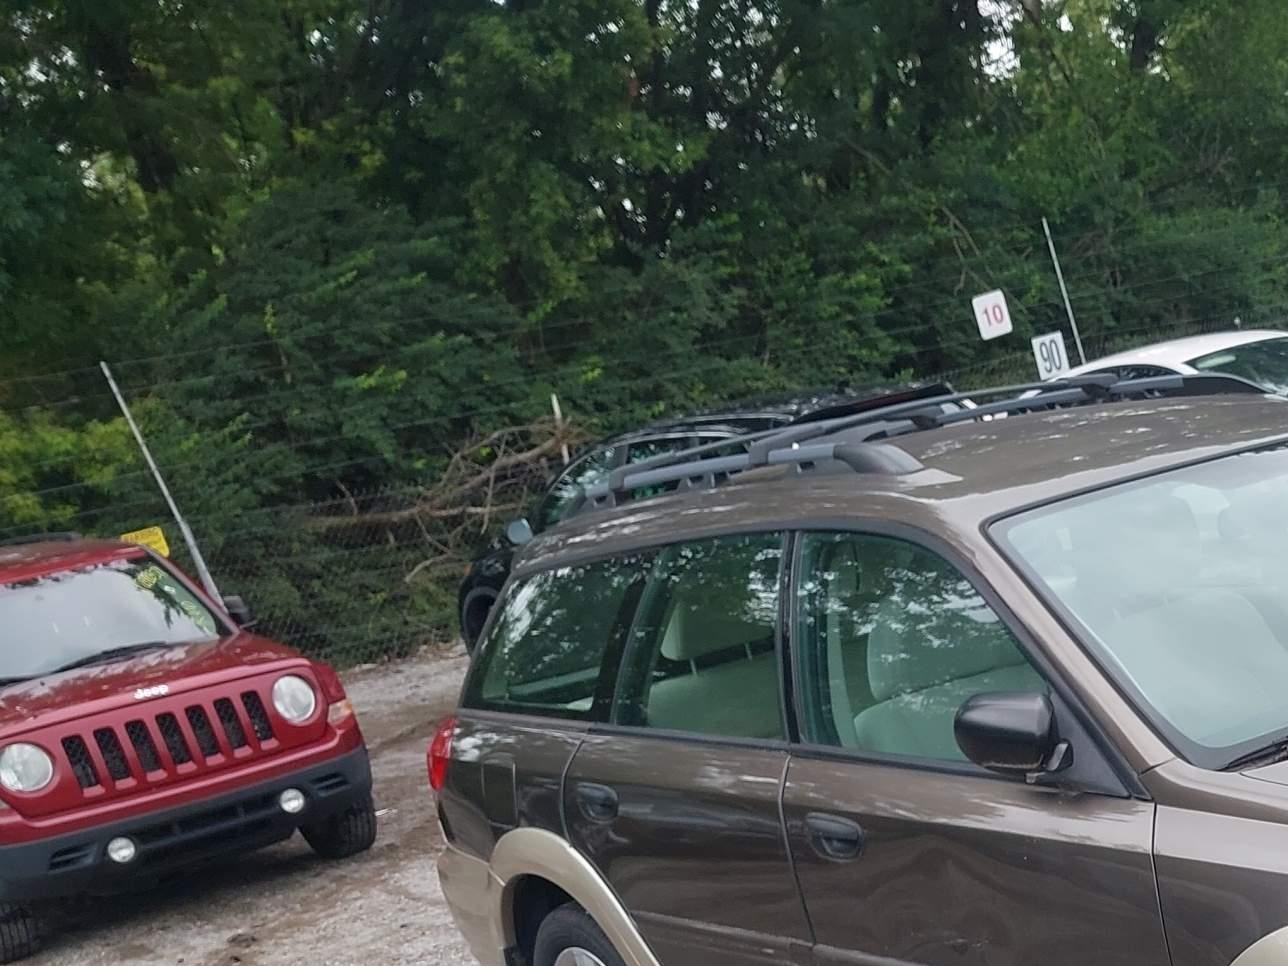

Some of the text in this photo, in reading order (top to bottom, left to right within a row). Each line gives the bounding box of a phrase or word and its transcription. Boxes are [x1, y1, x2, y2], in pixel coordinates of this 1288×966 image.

[983, 304, 1004, 327] 10
[1040, 339, 1062, 373] 90
[133, 684, 169, 700] Jeep
